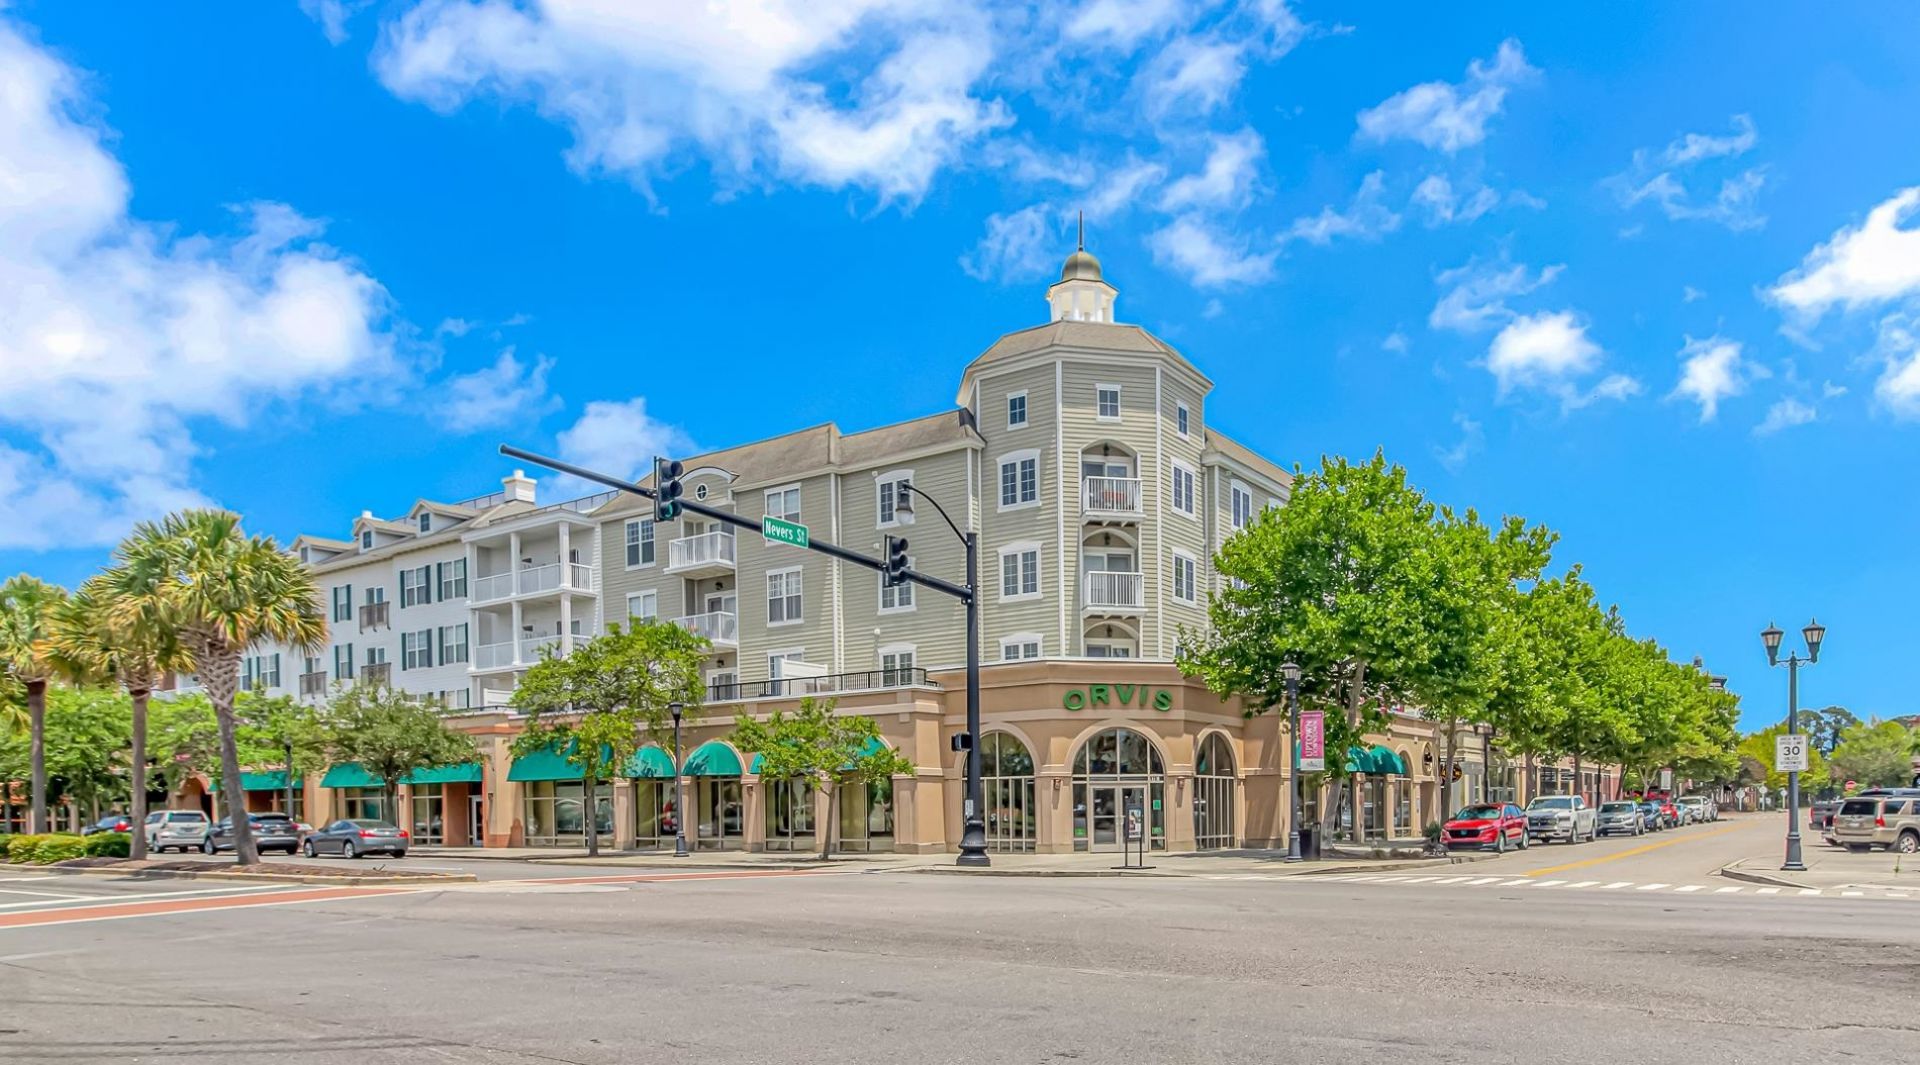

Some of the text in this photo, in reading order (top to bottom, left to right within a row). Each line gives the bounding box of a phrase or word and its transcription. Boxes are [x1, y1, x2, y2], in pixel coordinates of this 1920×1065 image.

[765, 520, 805, 544] Nevers St
[1063, 684, 1173, 711] ORVIS
[1305, 720, 1313, 757] UPTOWN
[1783, 746, 1800, 756] 30
